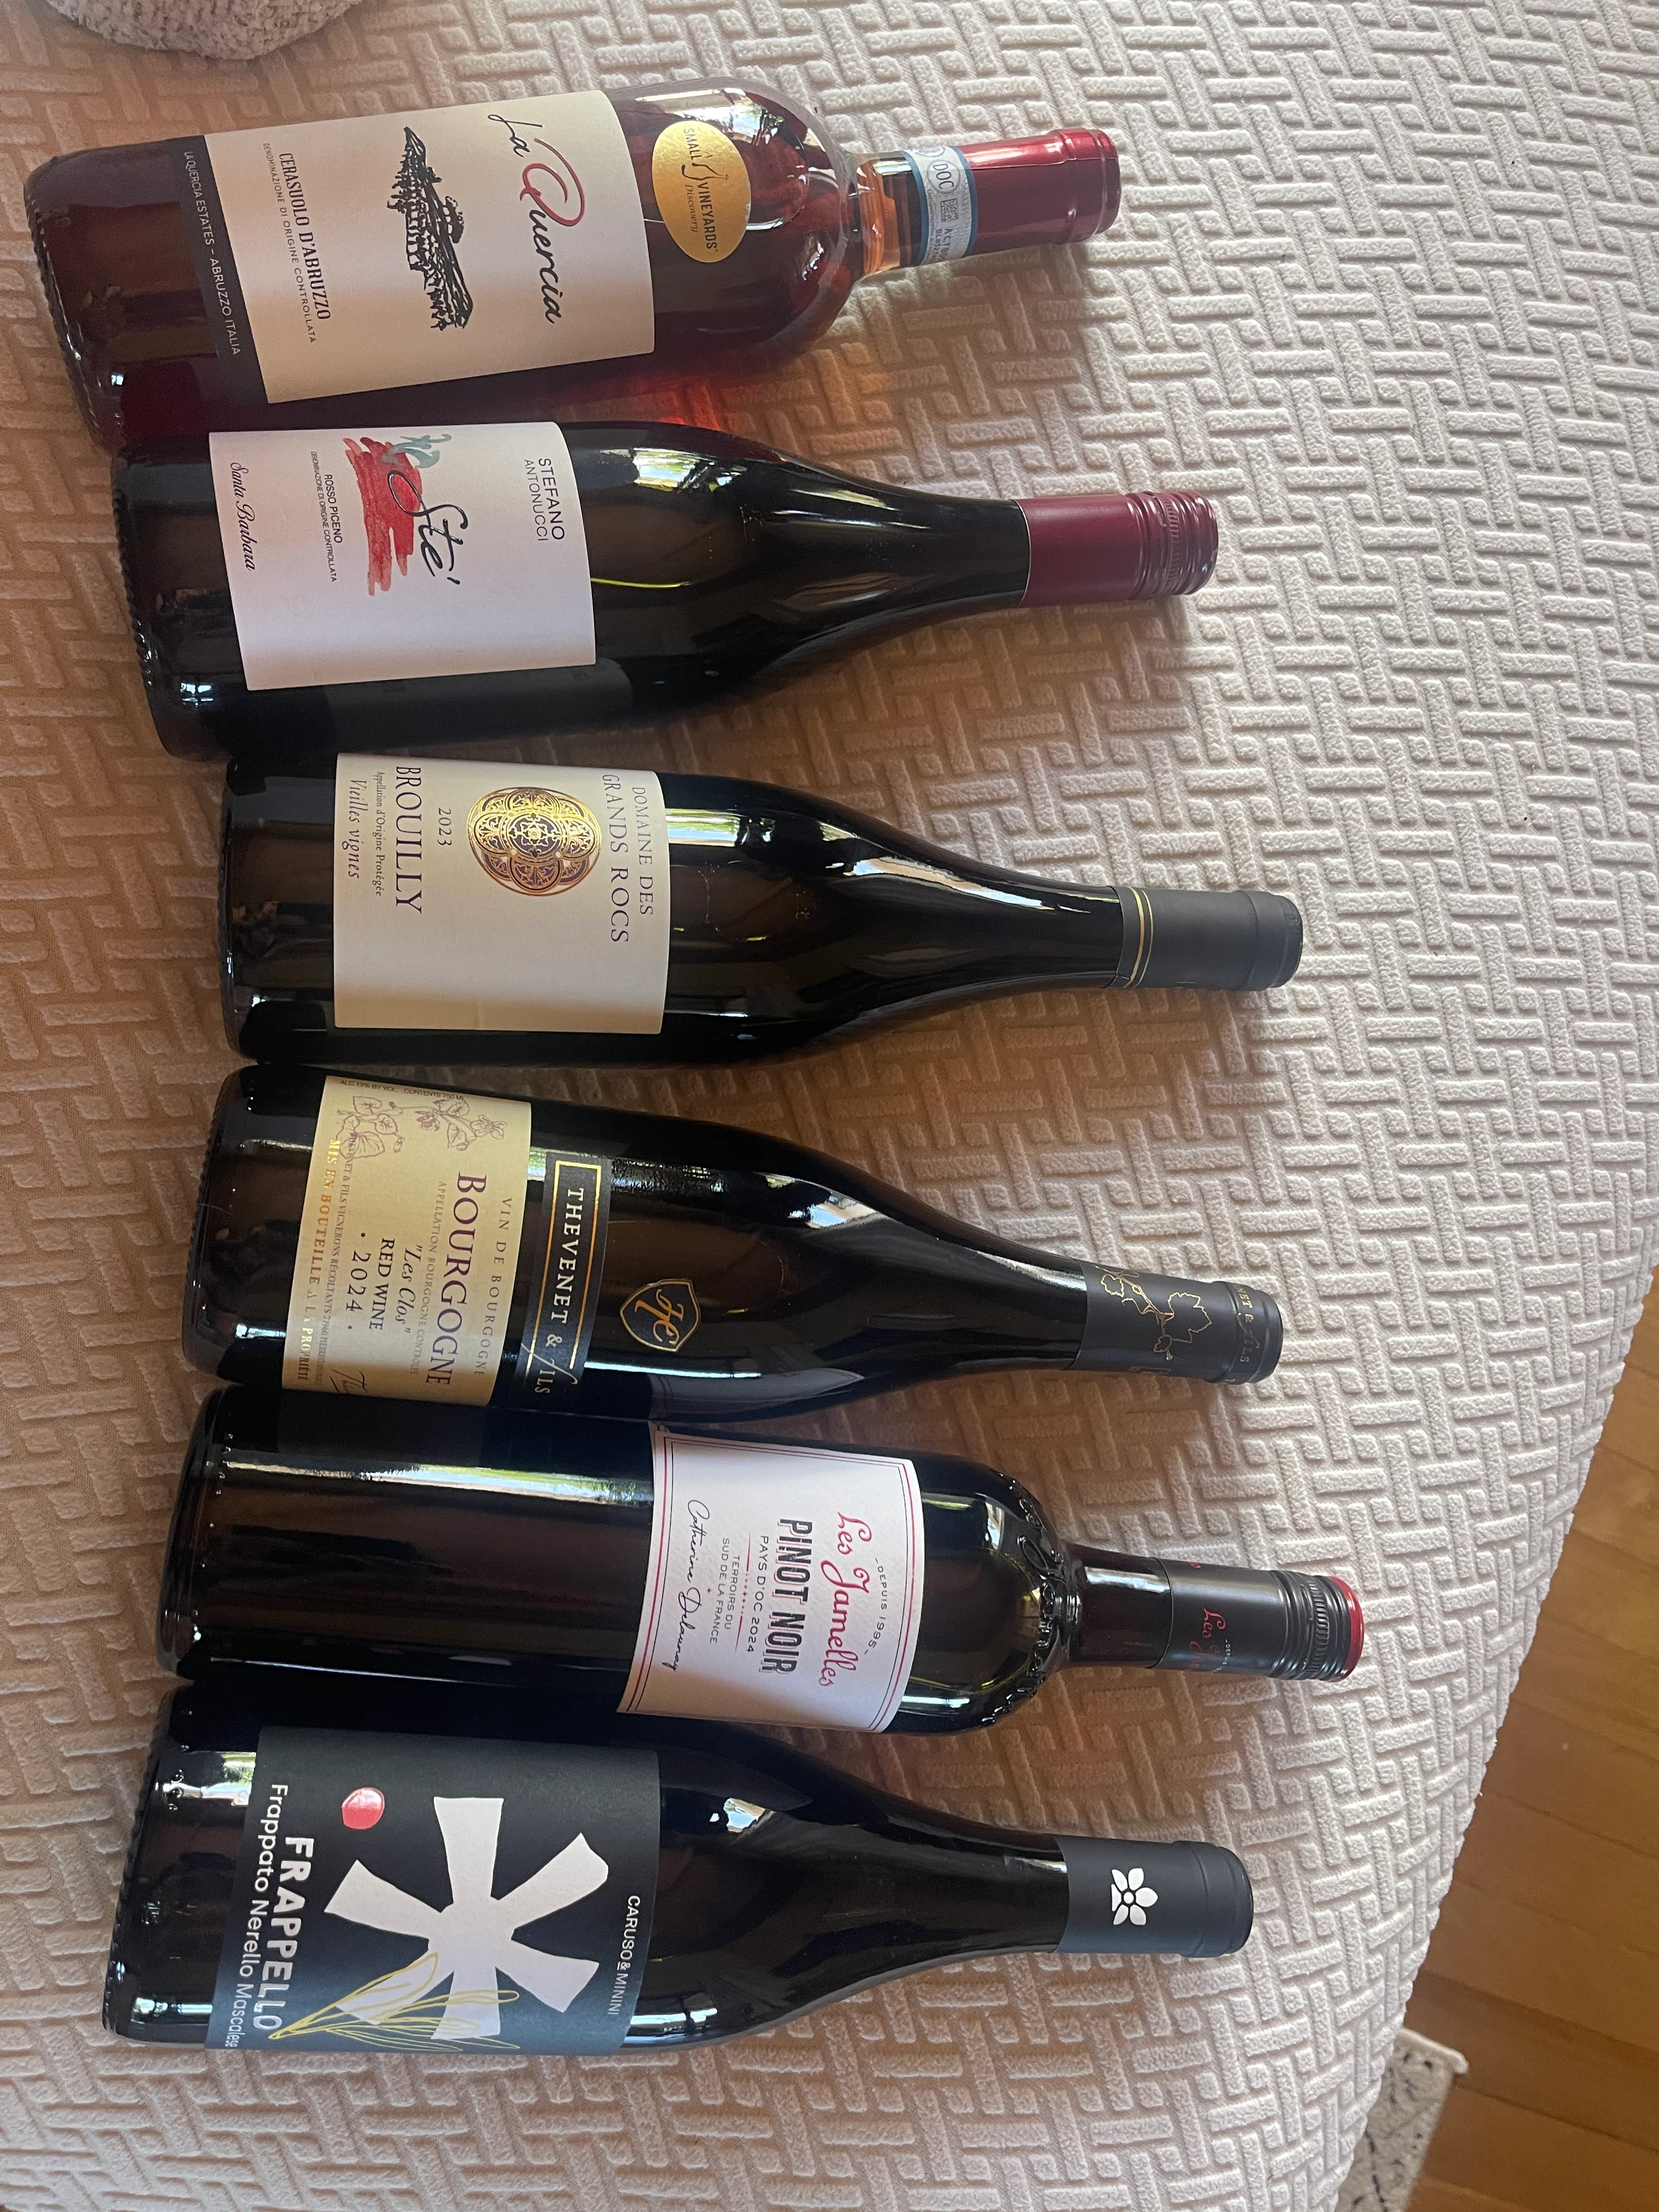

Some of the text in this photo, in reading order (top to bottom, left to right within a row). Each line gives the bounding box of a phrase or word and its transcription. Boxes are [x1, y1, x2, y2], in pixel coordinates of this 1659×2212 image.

[184, 151, 192, 160] LA
[186, 160, 203, 198] QUERCIA
[684, 128, 718, 250] SMALL VINEYARDS
[933, 163, 955, 190] DOC
[195, 200, 215, 245] ESTATES
[263, 143, 316, 343] DENOMINAZIONE DI ORIGINE CONTROLLATA
[279, 153, 331, 320] CERASUOLO D'ABRUZZO
[487, 114, 585, 324] La Quercia
[685, 184, 698, 233] Discovery
[210, 257, 232, 317] ABRUZZO
[224, 319, 241, 356] ITALIA
[230, 462, 257, 572] Santa Barbara
[319, 501, 329, 528] ORIGINE
[324, 529, 337, 583] CONTROLLATA
[324, 474, 343, 544] ROSSO PICENO
[523, 459, 548, 541] ANTONUCCI
[538, 458, 565, 540] STEFANO
[342, 780, 368, 879] Vieilles vignes
[372, 771, 386, 896] Appellation d'Origine Protégée
[395, 766, 422, 915] BROUILLY
[437, 807, 453, 847] 2023
[602, 774, 629, 943] GRANDS ROCS
[632, 787, 653, 915] DOMAINE DES
[404, 1087, 441, 1098] CONTENTS
[323, 1169, 336, 1189] EN
[327, 1139, 341, 1164] MIS
[340, 1184, 350, 1203] FILS
[309, 1194, 332, 1285] BOUTEILLE
[331, 1204, 347, 1257] VIGNERONS
[429, 1181, 447, 1254] APPELLATION
[551, 1187, 584, 1324] THEVENET
[346, 1250, 371, 1312] 2024
[368, 1237, 396, 1330] RED WINE
[417, 1257, 436, 1328] BOURGOGNE
[425, 1171, 488, 1386] BOURGOGNE
[473, 1197, 512, 1376] VIN DE BOURGOGNE
[545, 1333, 563, 1347] &
[662, 1499, 710, 1672] Catherine Delaunay
[709, 1537, 730, 1644] SUD DE LA FRANCE
[724, 1554, 740, 1630] TERROIRS DU
[746, 1535, 769, 1653] PAYS D'OC 2024
[759, 1518, 813, 1674] PINOT NOIR
[819, 1511, 872, 1686] Les Jamelles
[1202, 1607, 1226, 1639] Les
[224, 1784, 289, 2048] Frappato Nerello Mascalese
[252, 1837, 315, 2030] FRAPPELLO
[607, 1895, 641, 2015] CARUSO & MININI
